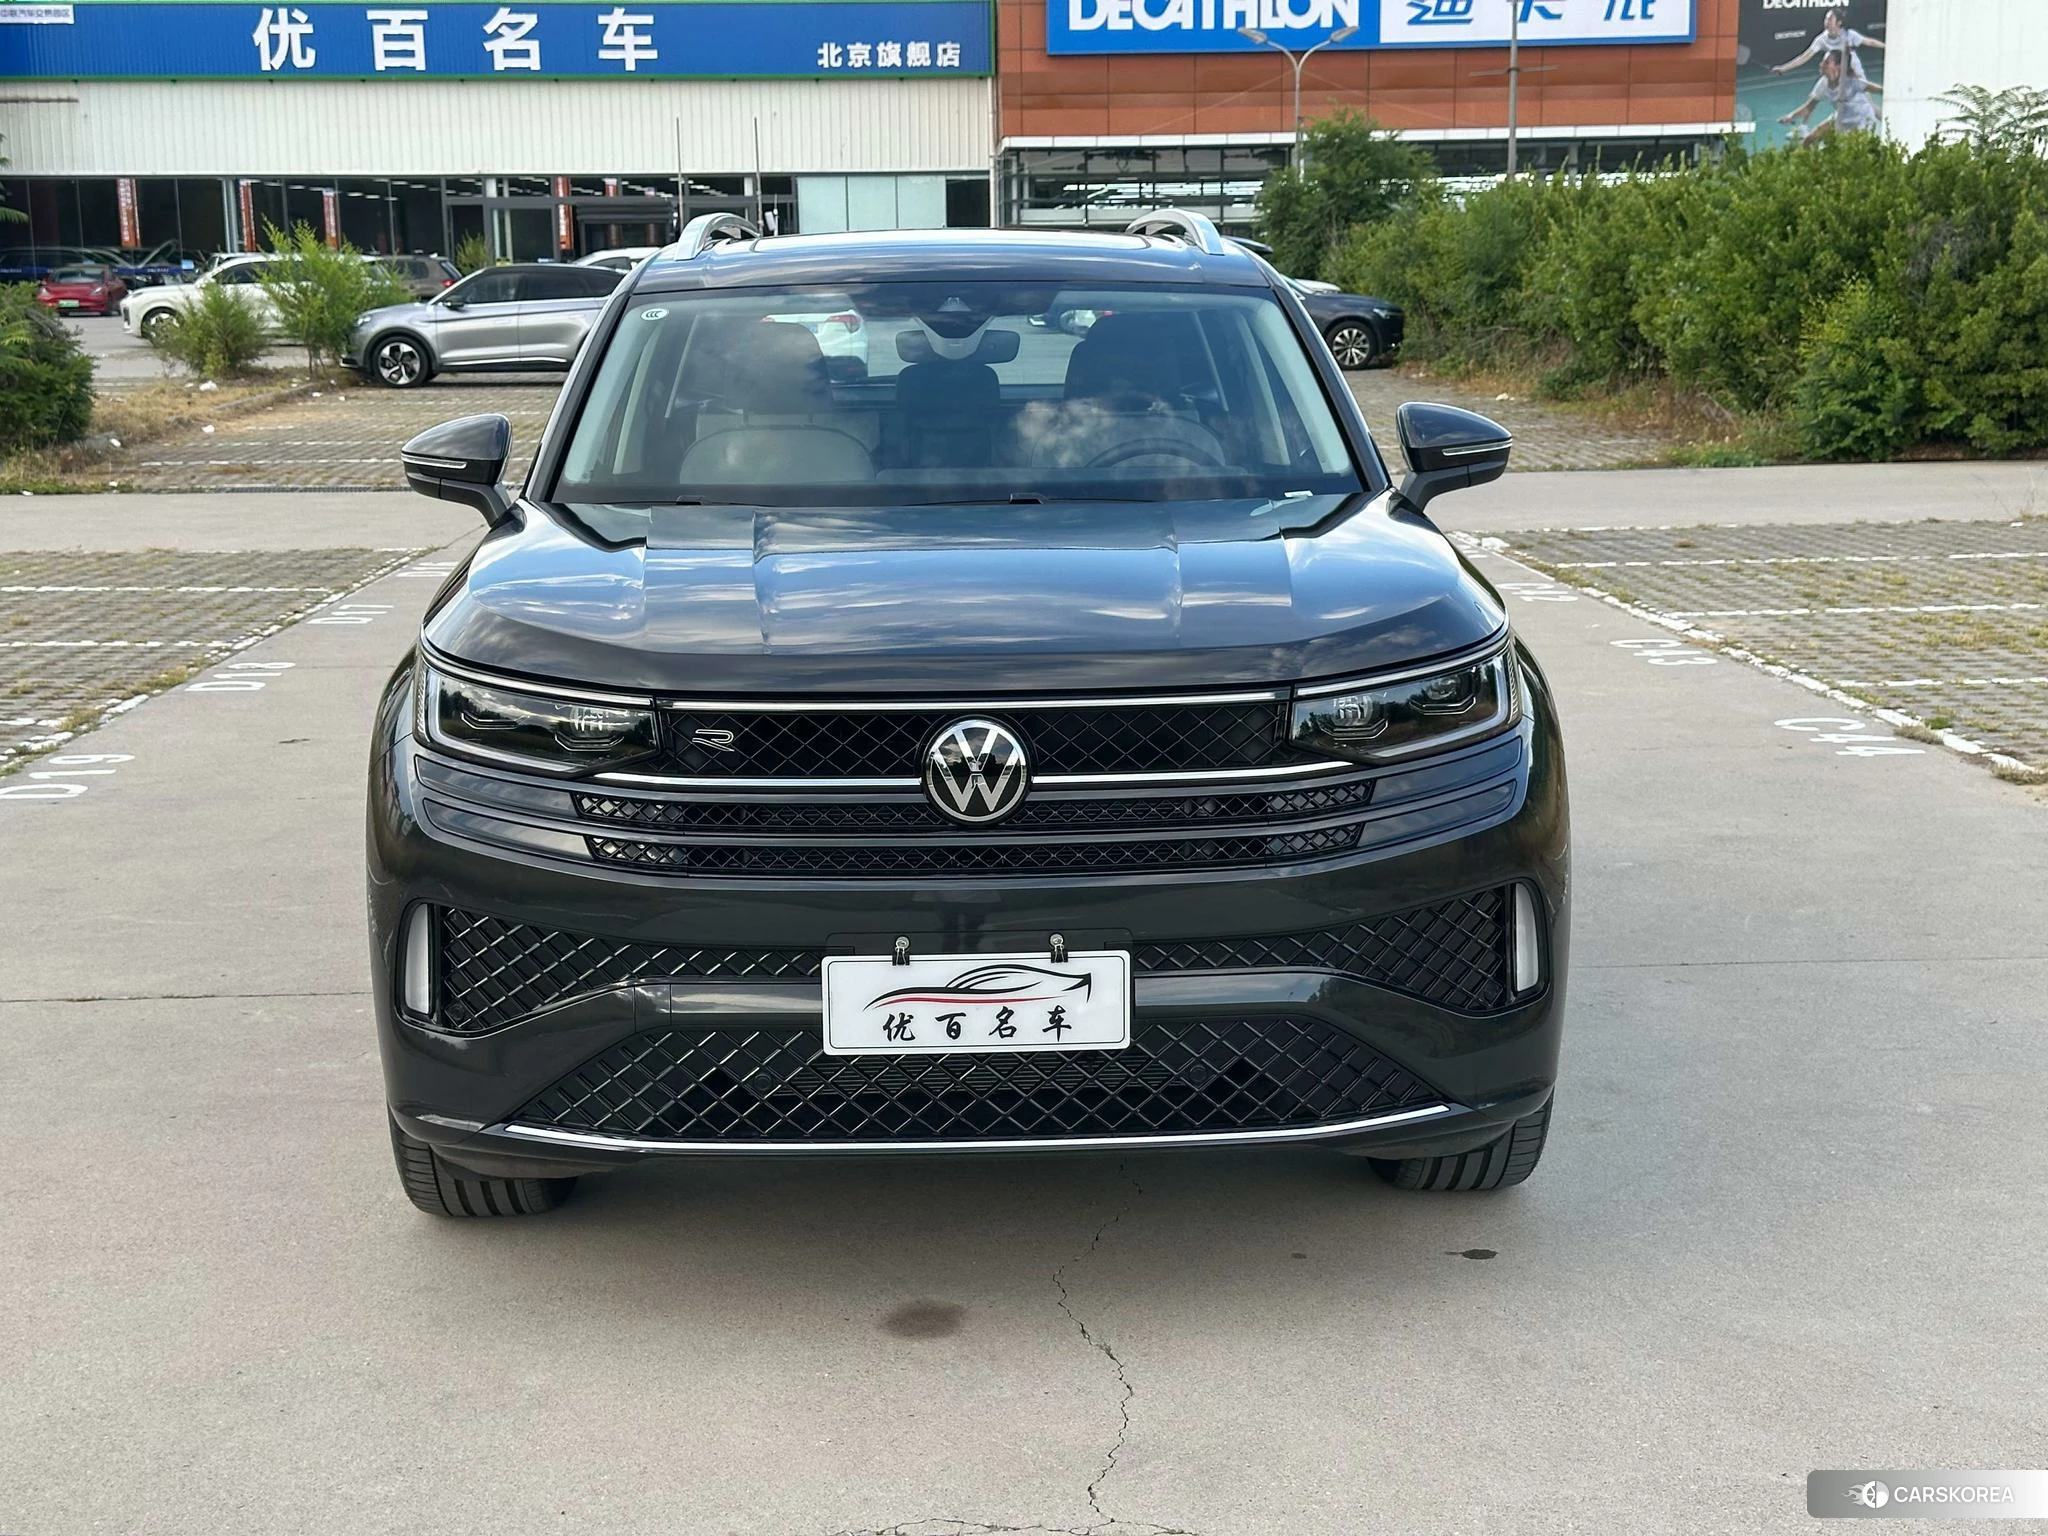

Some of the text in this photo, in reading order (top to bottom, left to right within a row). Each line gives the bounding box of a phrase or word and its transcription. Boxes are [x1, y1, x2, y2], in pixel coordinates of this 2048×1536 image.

[1068, 0, 1359, 31] DECATHLON
[252, 7, 659, 72] 优百名车
[817, 41, 961, 69] 北京旗舰店
[184, 662, 297, 692] D18
[0, 754, 136, 799] D19
[882, 1004, 1072, 1042] 优百名车
